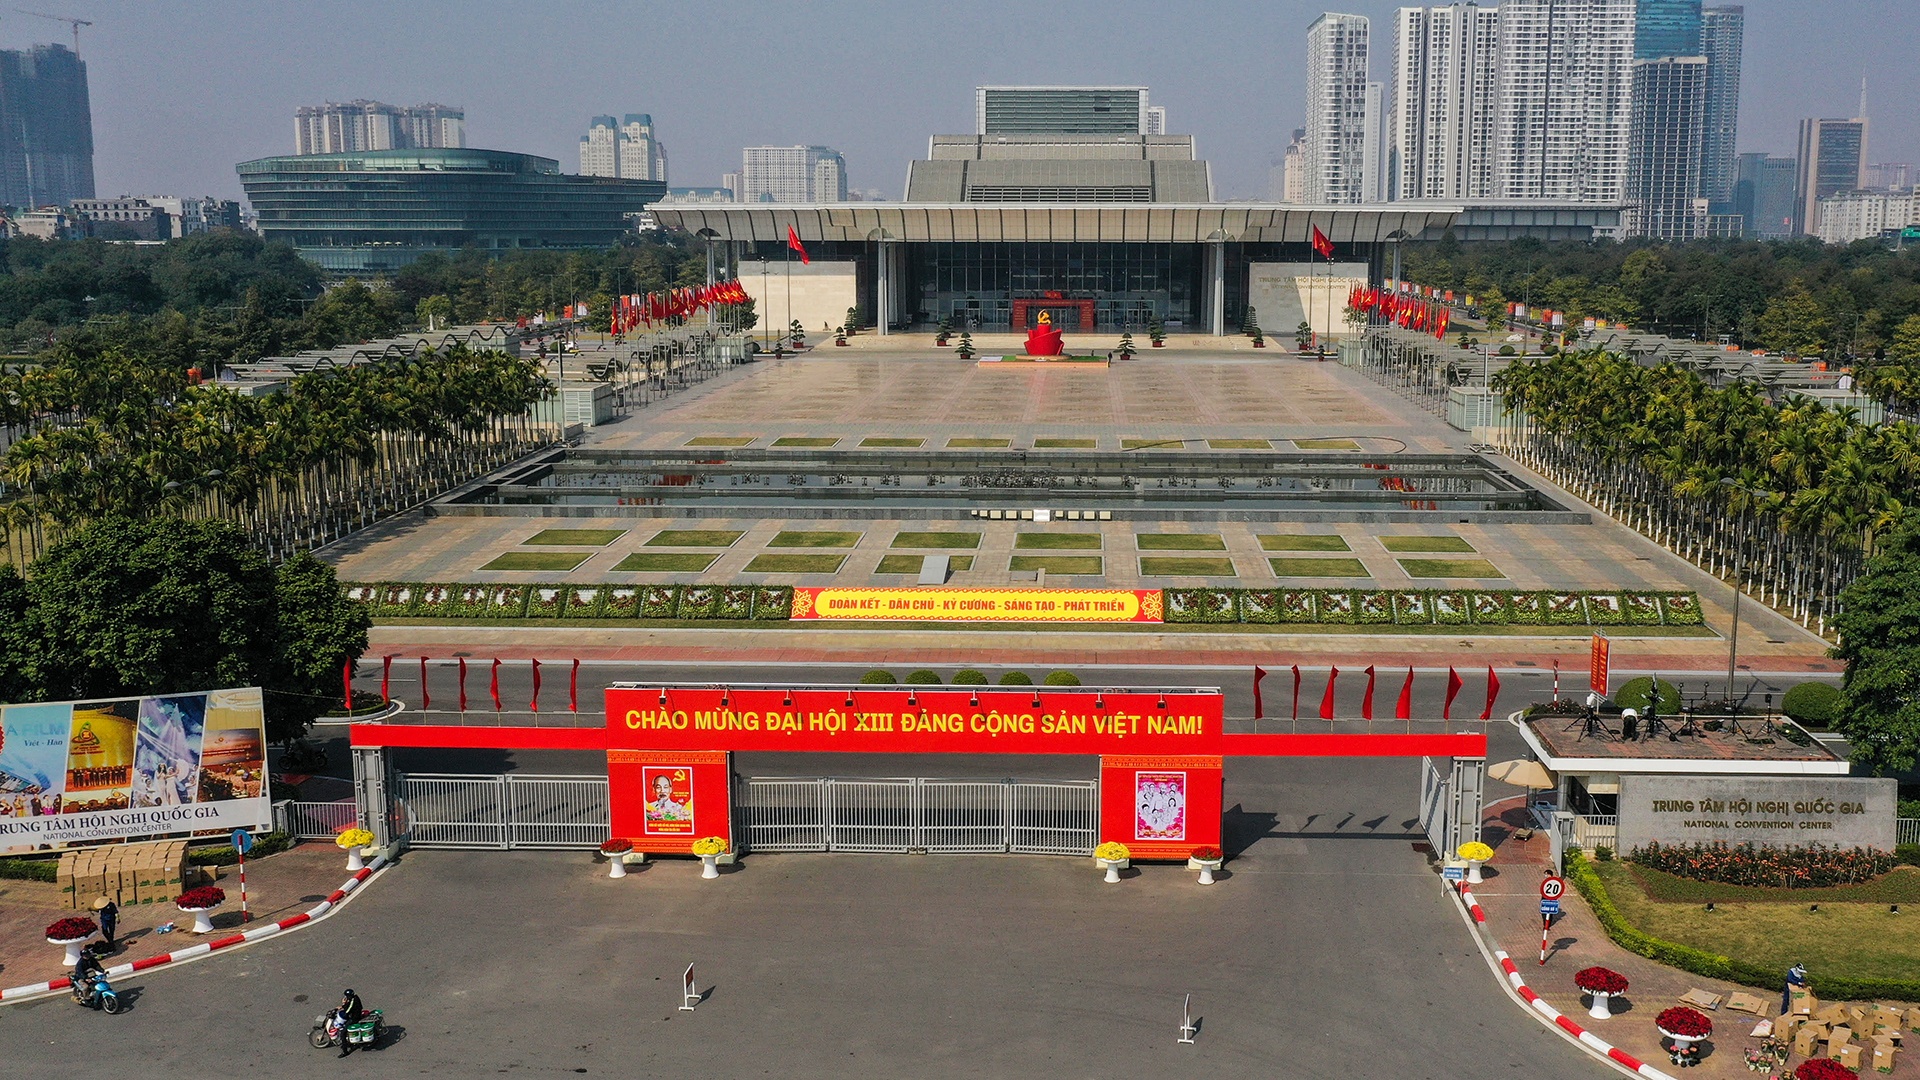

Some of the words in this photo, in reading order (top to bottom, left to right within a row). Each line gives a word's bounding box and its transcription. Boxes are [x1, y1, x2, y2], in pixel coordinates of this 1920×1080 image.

[860, 597, 880, 609] KẾT
[889, 598, 910, 610] DÂN
[912, 597, 935, 610] CHỦ
[943, 598, 957, 610] KỶ
[959, 598, 996, 611] CƯƠNG
[1004, 599, 1033, 611] SÁNG
[1035, 600, 1055, 613] TẠO
[1064, 599, 1091, 611] PHÁT
[1093, 597, 1125, 612] TRIỂN
[625, 706, 689, 730] CHÀO
[695, 707, 760, 731] MỪNG
[765, 711, 803, 736] ĐẠI
[809, 708, 847, 736] HỘI
[853, 713, 894, 732] XIII
[900, 708, 964, 733] ĐẢNG
[970, 709, 1034, 737] CỘNG
[1040, 710, 1087, 734] SẢN
[1092, 711, 1141, 739] VIỆT
[1147, 715, 1203, 735] NAM!
[1652, 800, 1695, 813] TRUNG
[1699, 798, 1725, 813] TÂM
[1728, 798, 1752, 816] HỘI
[1756, 801, 1789, 816] NGHỊ
[1794, 797, 1835, 814] QUỐC
[1839, 802, 1865, 815] GIA
[0, 821, 40, 834] RUNG
[43, 818, 75, 831] TÂM
[80, 814, 106, 829] HỘI
[110, 811, 147, 826] NGHỊ
[150, 806, 192, 823] QUỐC
[194, 807, 219, 819] GIA
[1683, 820, 1729, 829] NATIONAL
[1734, 820, 1794, 830] CONVENTION
[1799, 821, 1832, 830] CENTER
[43, 831, 84, 840] NATIONAL
[86, 826, 140, 837] CONVENTION
[141, 823, 172, 832] CENTER
[1545, 883, 1560, 895] 20
